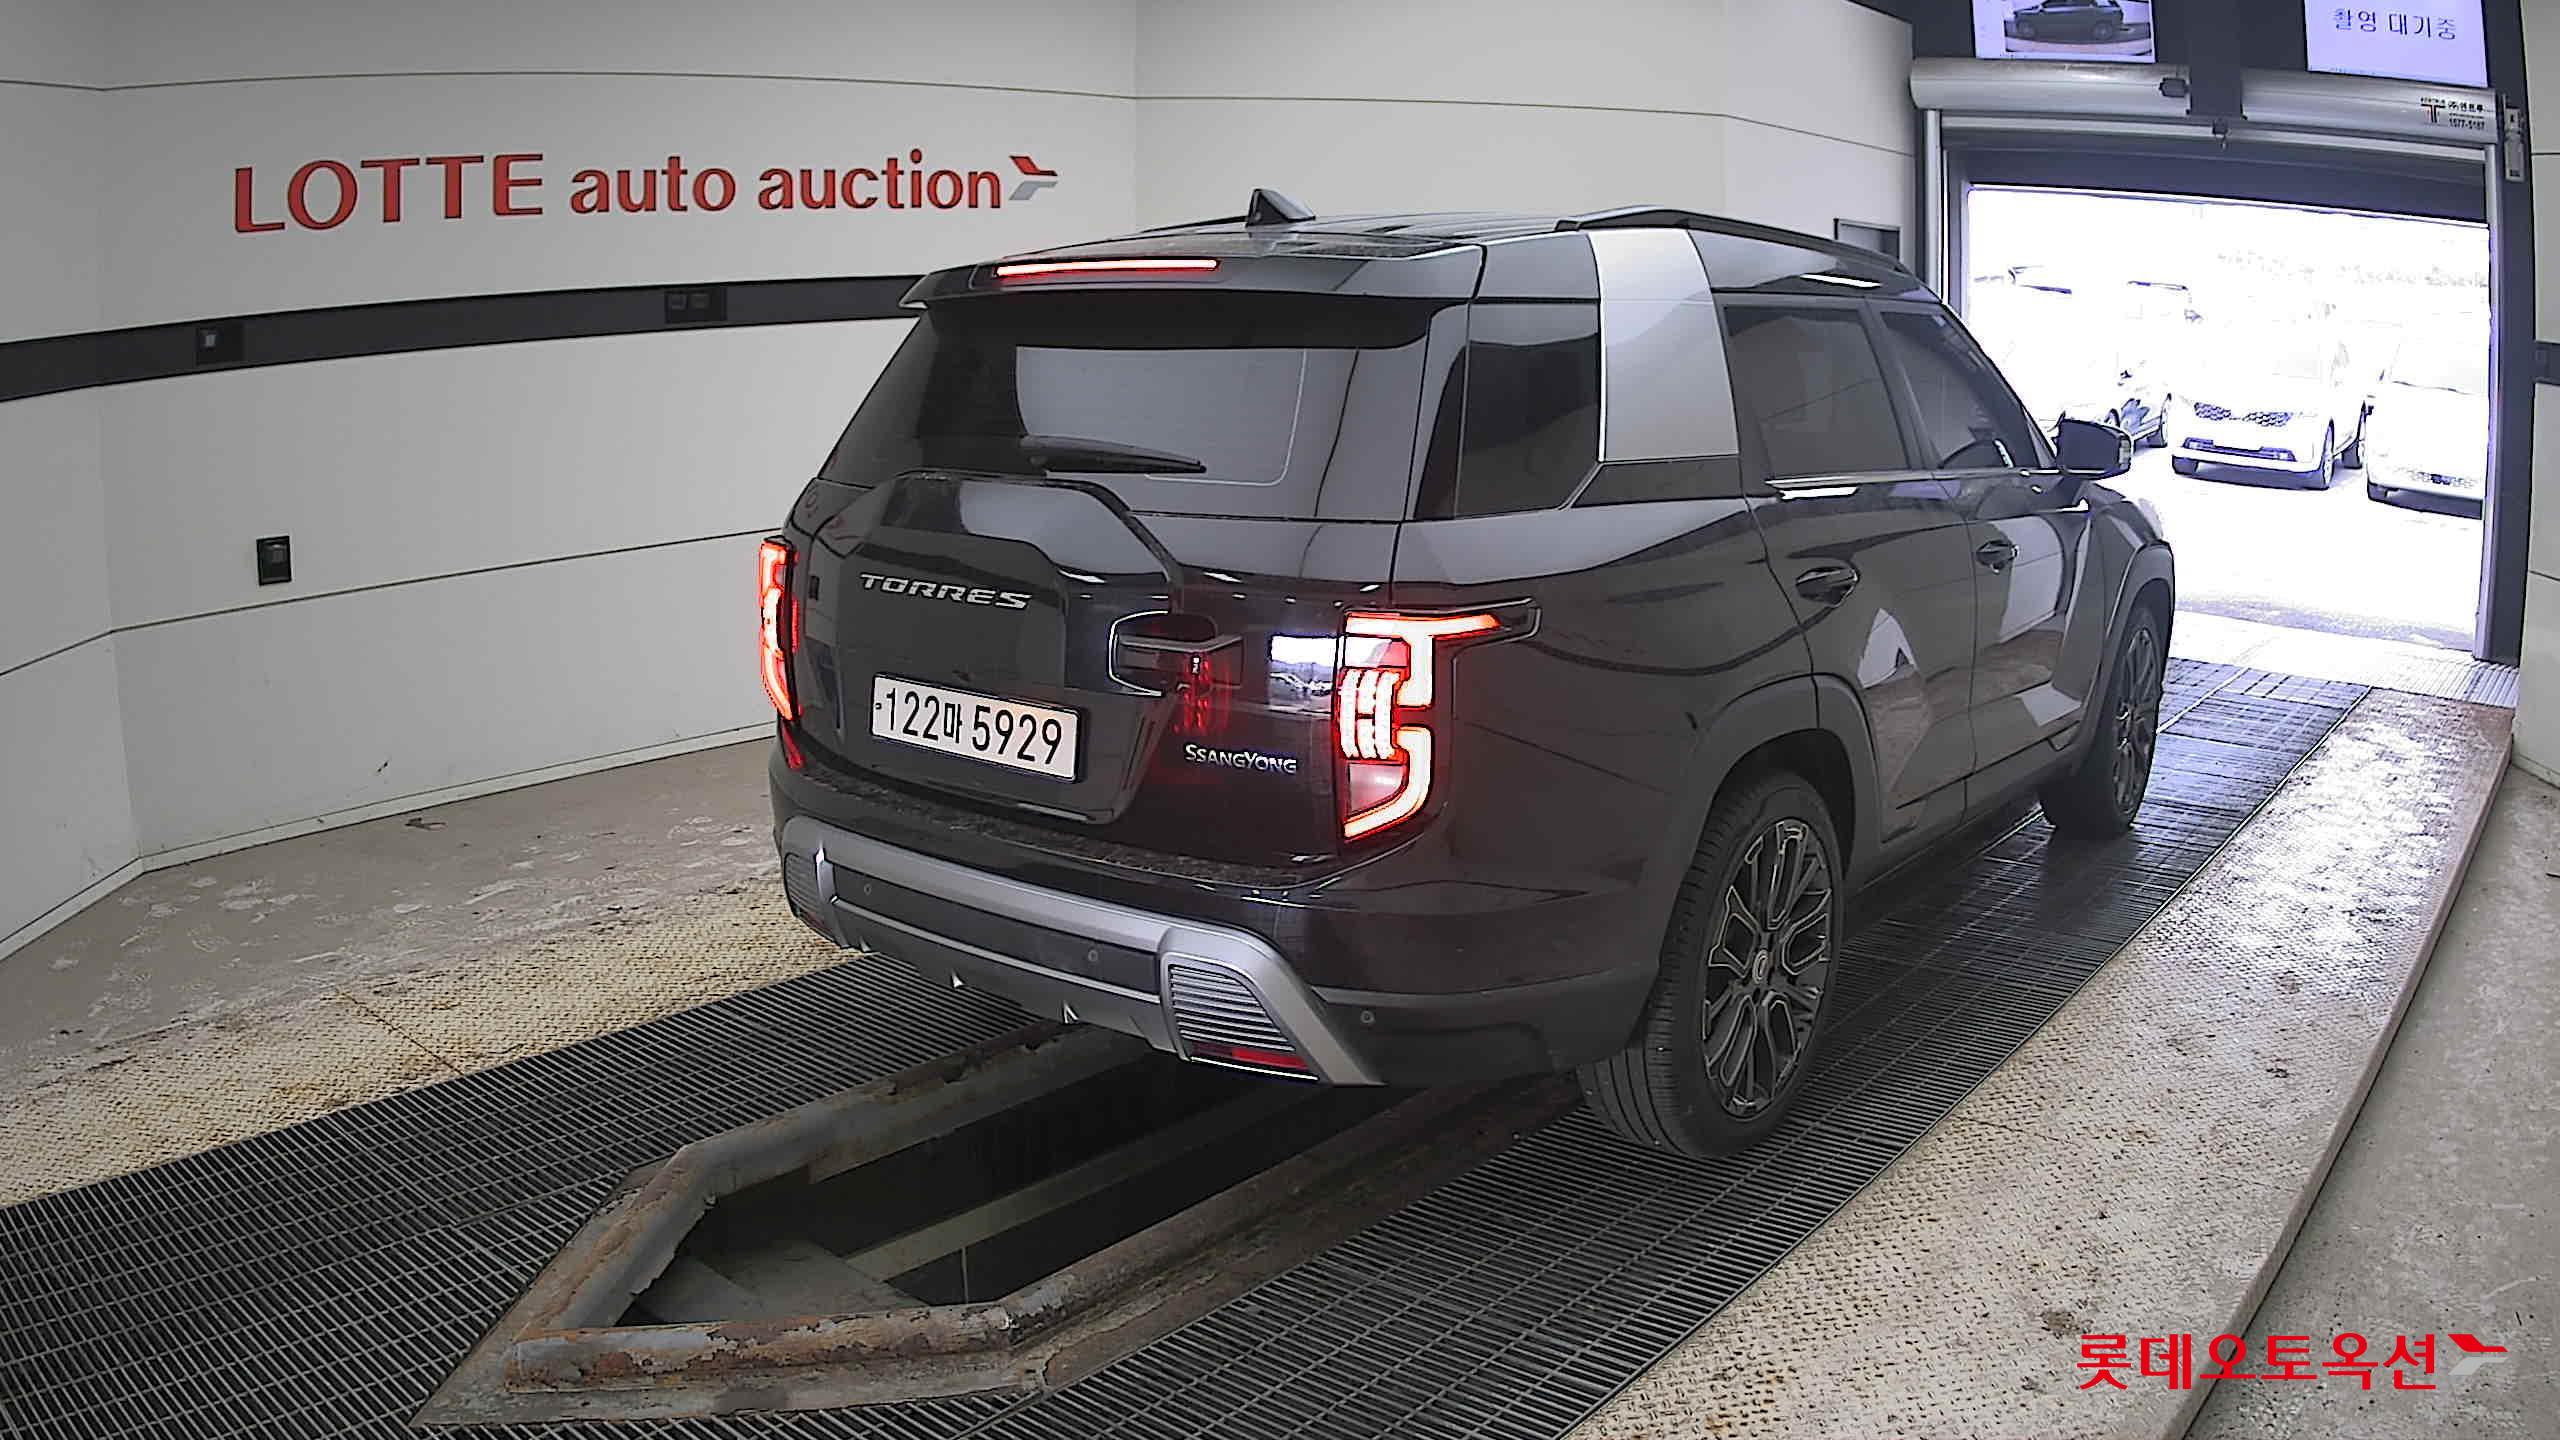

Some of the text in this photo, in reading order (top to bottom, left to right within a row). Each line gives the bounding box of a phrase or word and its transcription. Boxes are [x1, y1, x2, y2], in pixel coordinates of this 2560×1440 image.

[2388, 13, 2456, 40] 대기중
[235, 150, 1001, 234] LOTTE auto auction
[860, 572, 1032, 611] TORRES
[972, 705, 1063, 765] 5929
